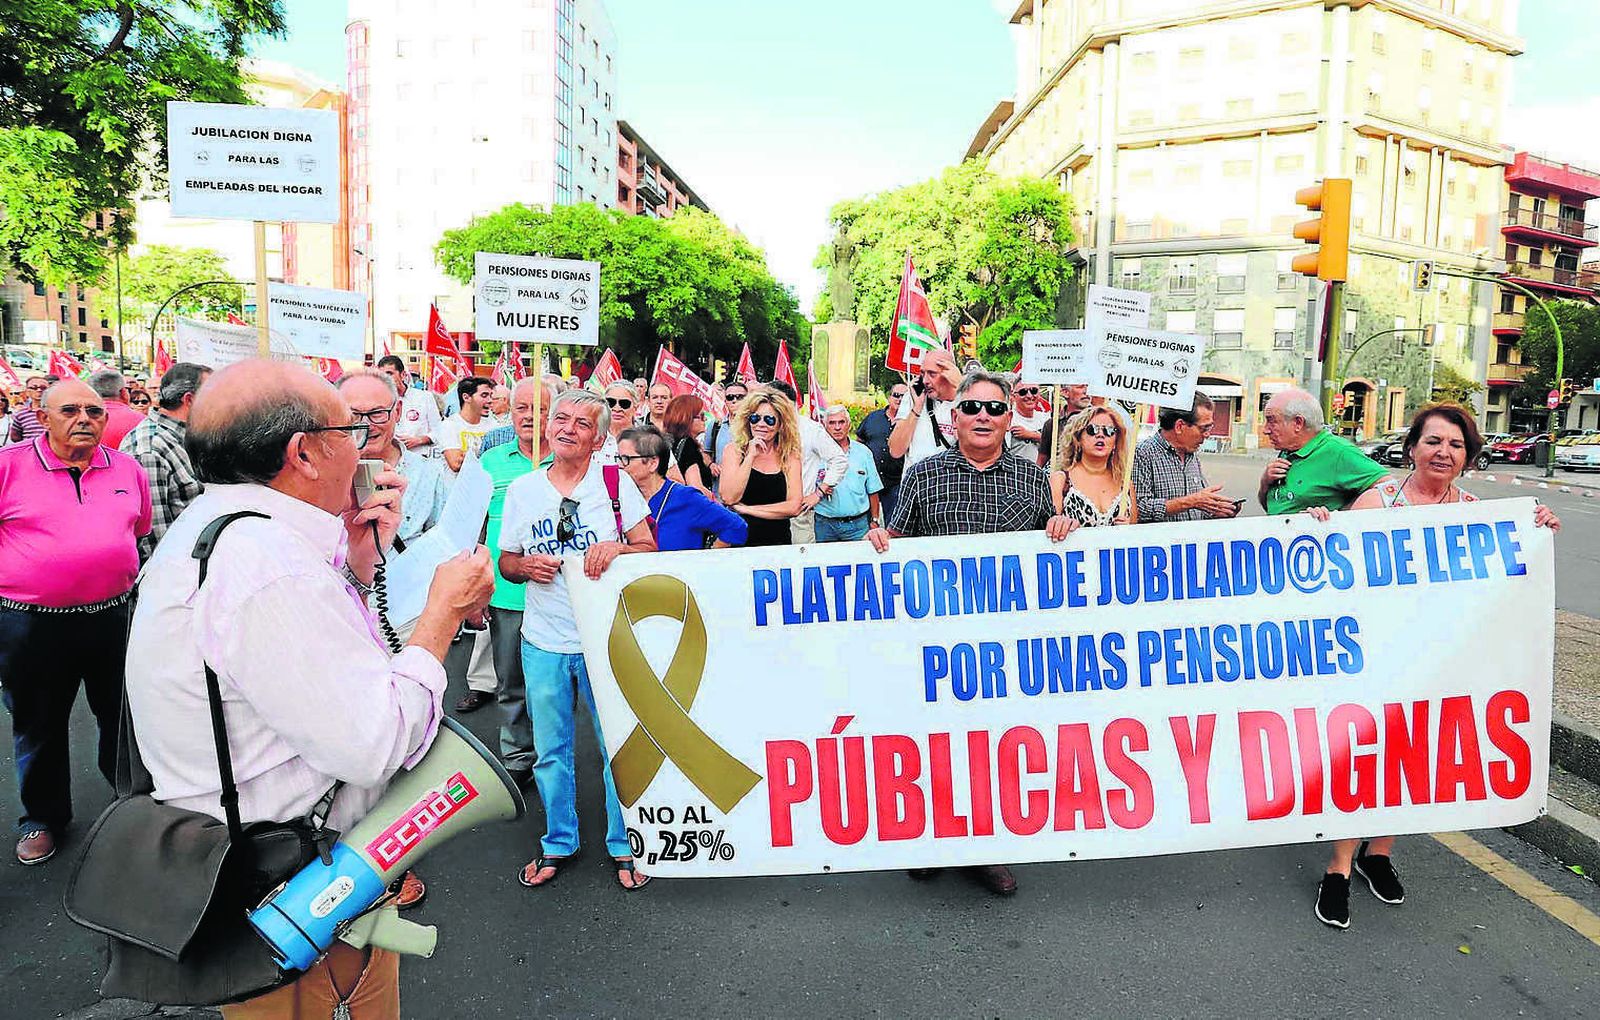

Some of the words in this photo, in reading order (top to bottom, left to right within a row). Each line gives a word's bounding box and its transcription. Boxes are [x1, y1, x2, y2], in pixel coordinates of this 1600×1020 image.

[192, 127, 269, 140] JUBILACION
[273, 132, 313, 142] DIGNA
[228, 155, 257, 164] PARA
[259, 156, 280, 165] LAS
[185, 180, 255, 192] EMPLEADAS
[258, 184, 280, 193] DEL
[283, 185, 323, 195] HOGAR
[487, 264, 548, 279] PENSIONES
[551, 269, 591, 282] DIGNAS
[517, 289, 542, 299] PARA
[544, 291, 560, 300] LAS
[270, 297, 312, 308] PENSIONES
[313, 302, 360, 315] SUFICIENTES
[283, 311, 302, 320] PARA
[304, 314, 318, 322] LAS
[320, 316, 346, 325] VIUDAS
[496, 311, 580, 331] MUJERES
[1106, 332, 1157, 348] PENSIONES
[1159, 341, 1195, 354] DIGNAS
[1128, 355, 1149, 365] PARA
[1150, 358, 1165, 368] LAS
[1106, 372, 1178, 396] MUJERES
[531, 518, 554, 540] NO
[752, 555, 1028, 627] PLATAFORMA
[1036, 551, 1088, 610] DE
[1097, 532, 1355, 606] JUBILADO@S
[1362, 528, 1418, 588] DE
[1422, 520, 1527, 583] LEPE
[922, 641, 1007, 702] POR
[1016, 632, 1128, 697] UNAS
[1137, 615, 1365, 687] PENSIONES
[765, 714, 1155, 847] PÚBLICAS
[1168, 713, 1217, 824] Y
[1237, 689, 1533, 821] DIGNAS
[638, 806, 674, 824] NO
[682, 806, 713, 824] AL
[375, 795, 453, 863] CCOO
[627, 827, 735, 865] 0,25%
